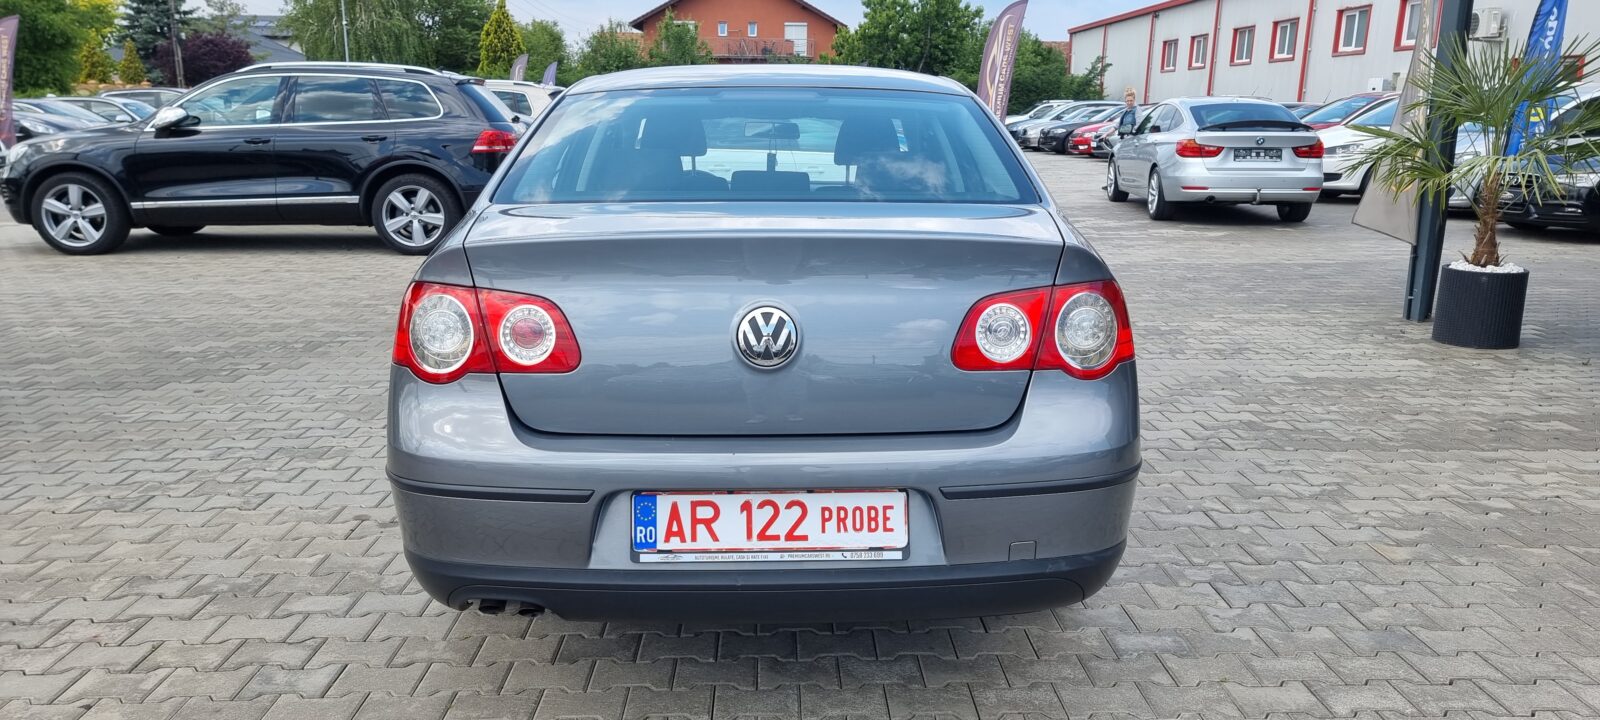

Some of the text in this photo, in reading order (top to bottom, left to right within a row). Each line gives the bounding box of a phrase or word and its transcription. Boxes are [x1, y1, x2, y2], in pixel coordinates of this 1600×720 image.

[999, 54, 1008, 82] CARS
[1005, 24, 1015, 52] WEST
[737, 306, 797, 366] VW
[636, 526, 656, 543] RO
[663, 499, 895, 543] AR 122 PROBE
